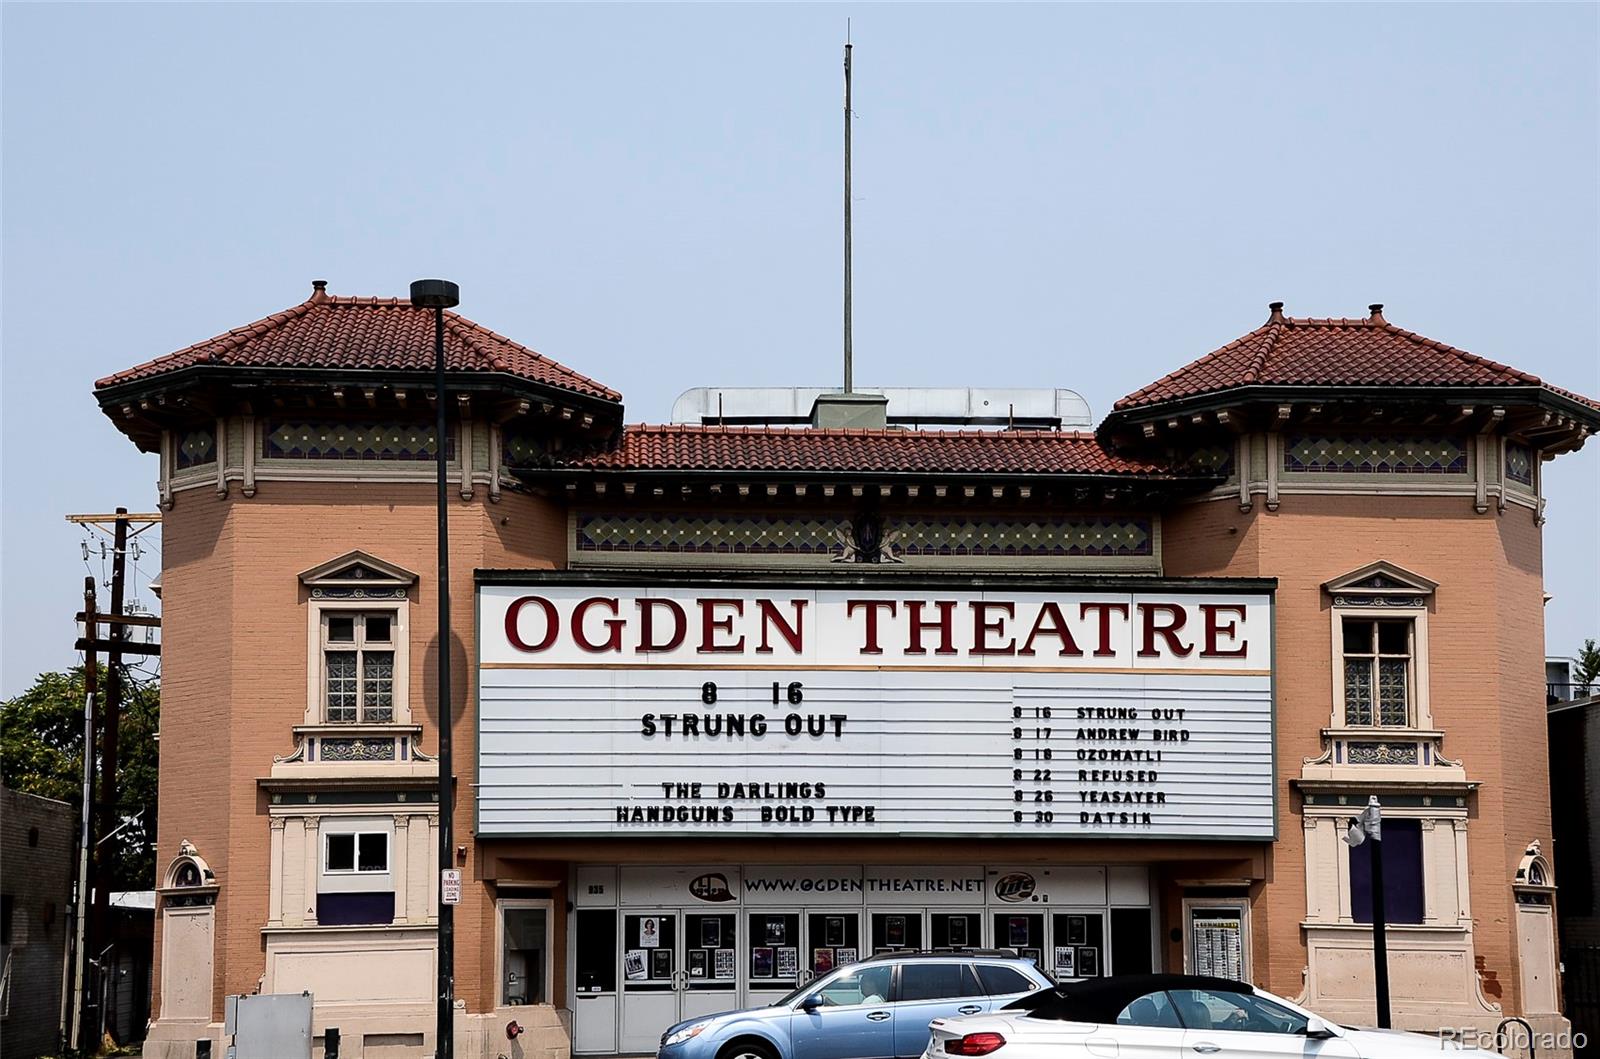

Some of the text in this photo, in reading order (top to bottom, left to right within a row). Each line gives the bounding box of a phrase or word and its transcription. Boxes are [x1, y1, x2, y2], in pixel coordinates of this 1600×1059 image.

[504, 595, 1248, 659] OGDEN THEATRE
[701, 681, 803, 705] 8 16
[1013, 706, 1186, 721] 8 16 STRUNG OUT
[640, 713, 848, 738] STRUNG OUT
[1013, 727, 1190, 742] 8 17 ANDREW BIRD
[1013, 748, 1162, 761] 8 18 OZOMATLI
[1013, 769, 1158, 783] 8 22 REFUSED
[661, 782, 826, 800] THE DARLINGS
[1014, 790, 1166, 804] 8 26 YEASAYER
[616, 805, 876, 823] HANDGUNS BOLD TYPE
[1013, 811, 1152, 824] 8 30 DATSIK
